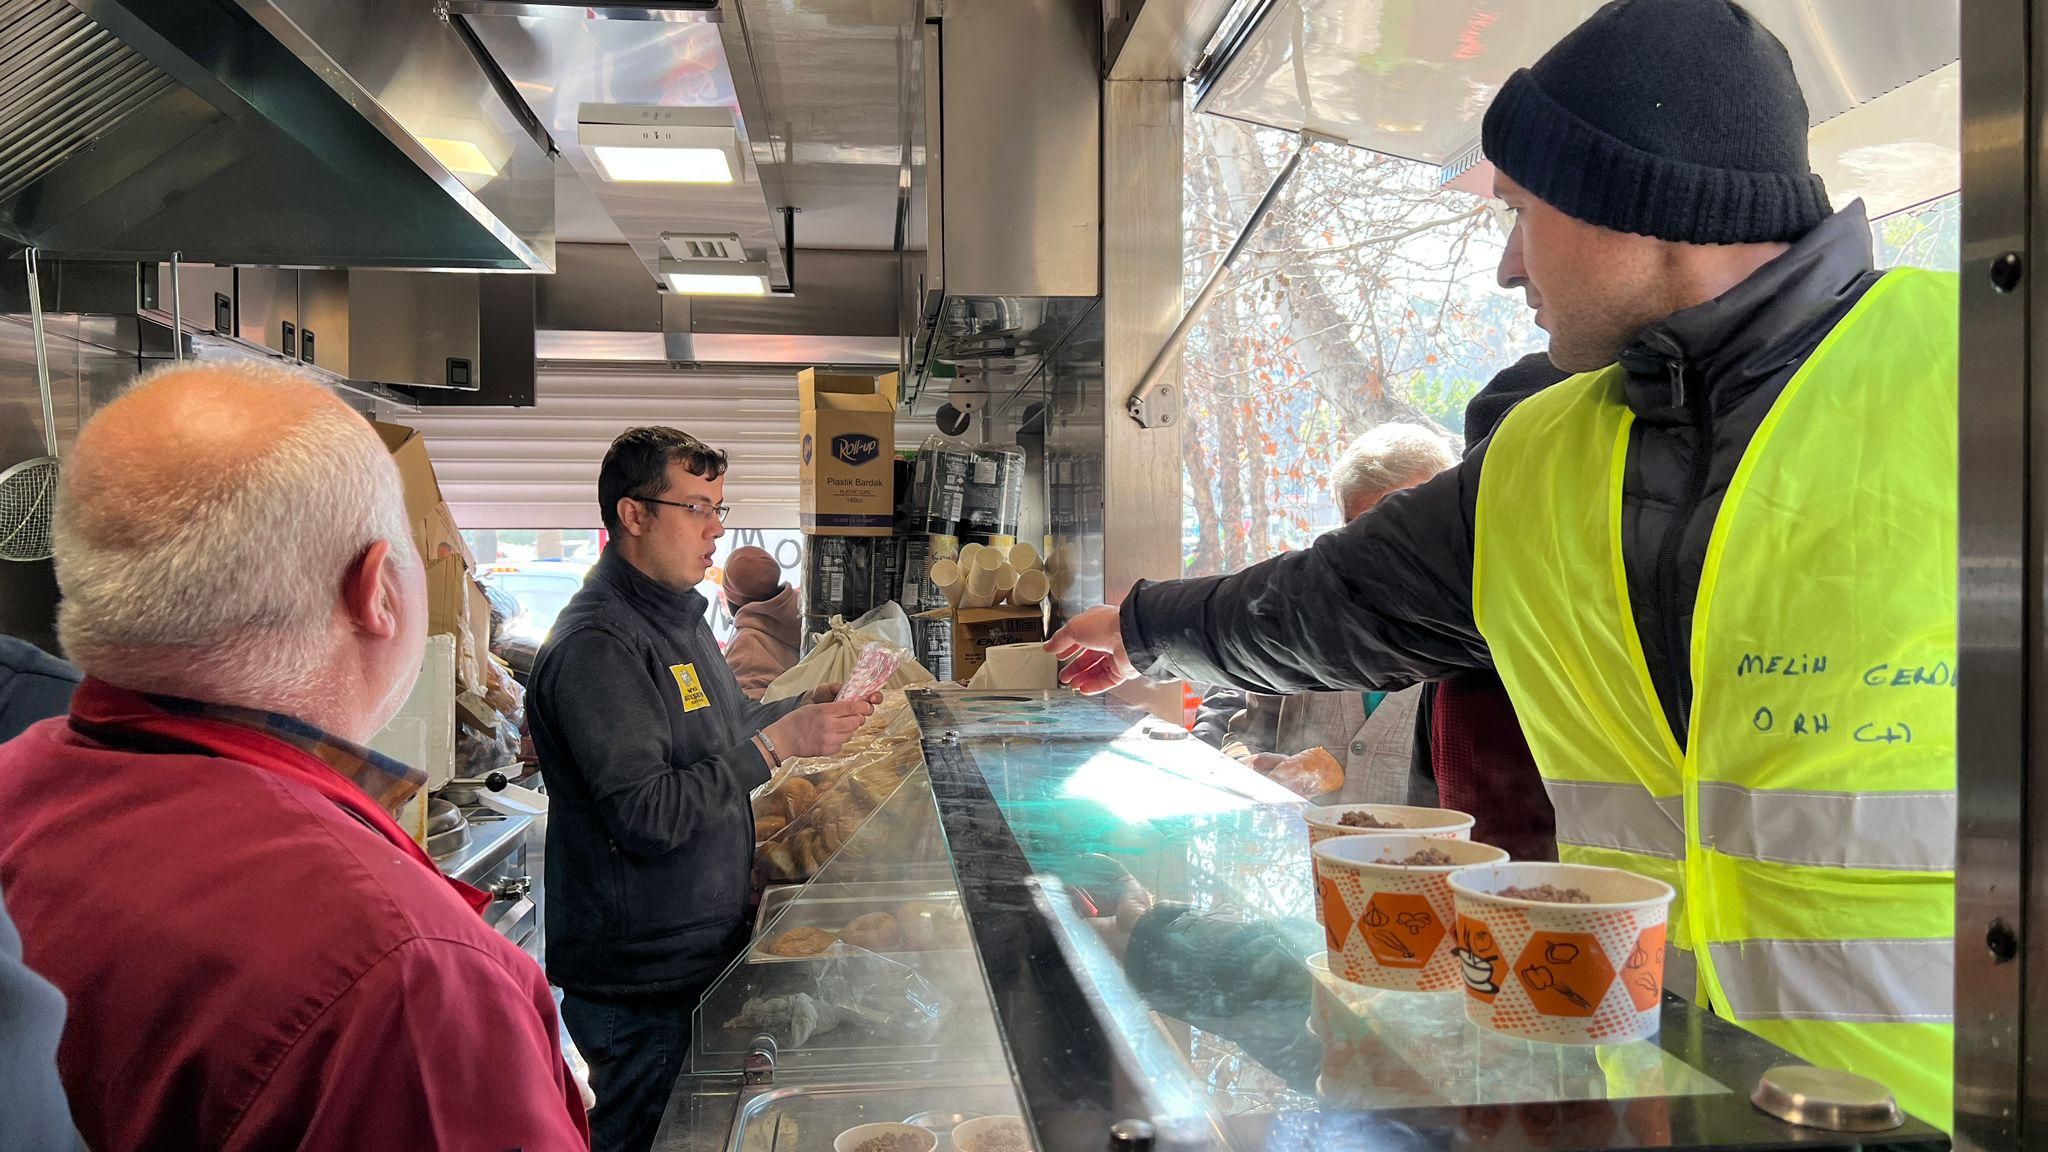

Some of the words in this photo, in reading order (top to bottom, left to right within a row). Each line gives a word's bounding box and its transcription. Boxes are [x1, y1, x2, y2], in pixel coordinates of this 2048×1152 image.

[827, 477, 853, 486] Plastik
[856, 478, 883, 487] Bardak
[1794, 713, 1830, 734] RH
